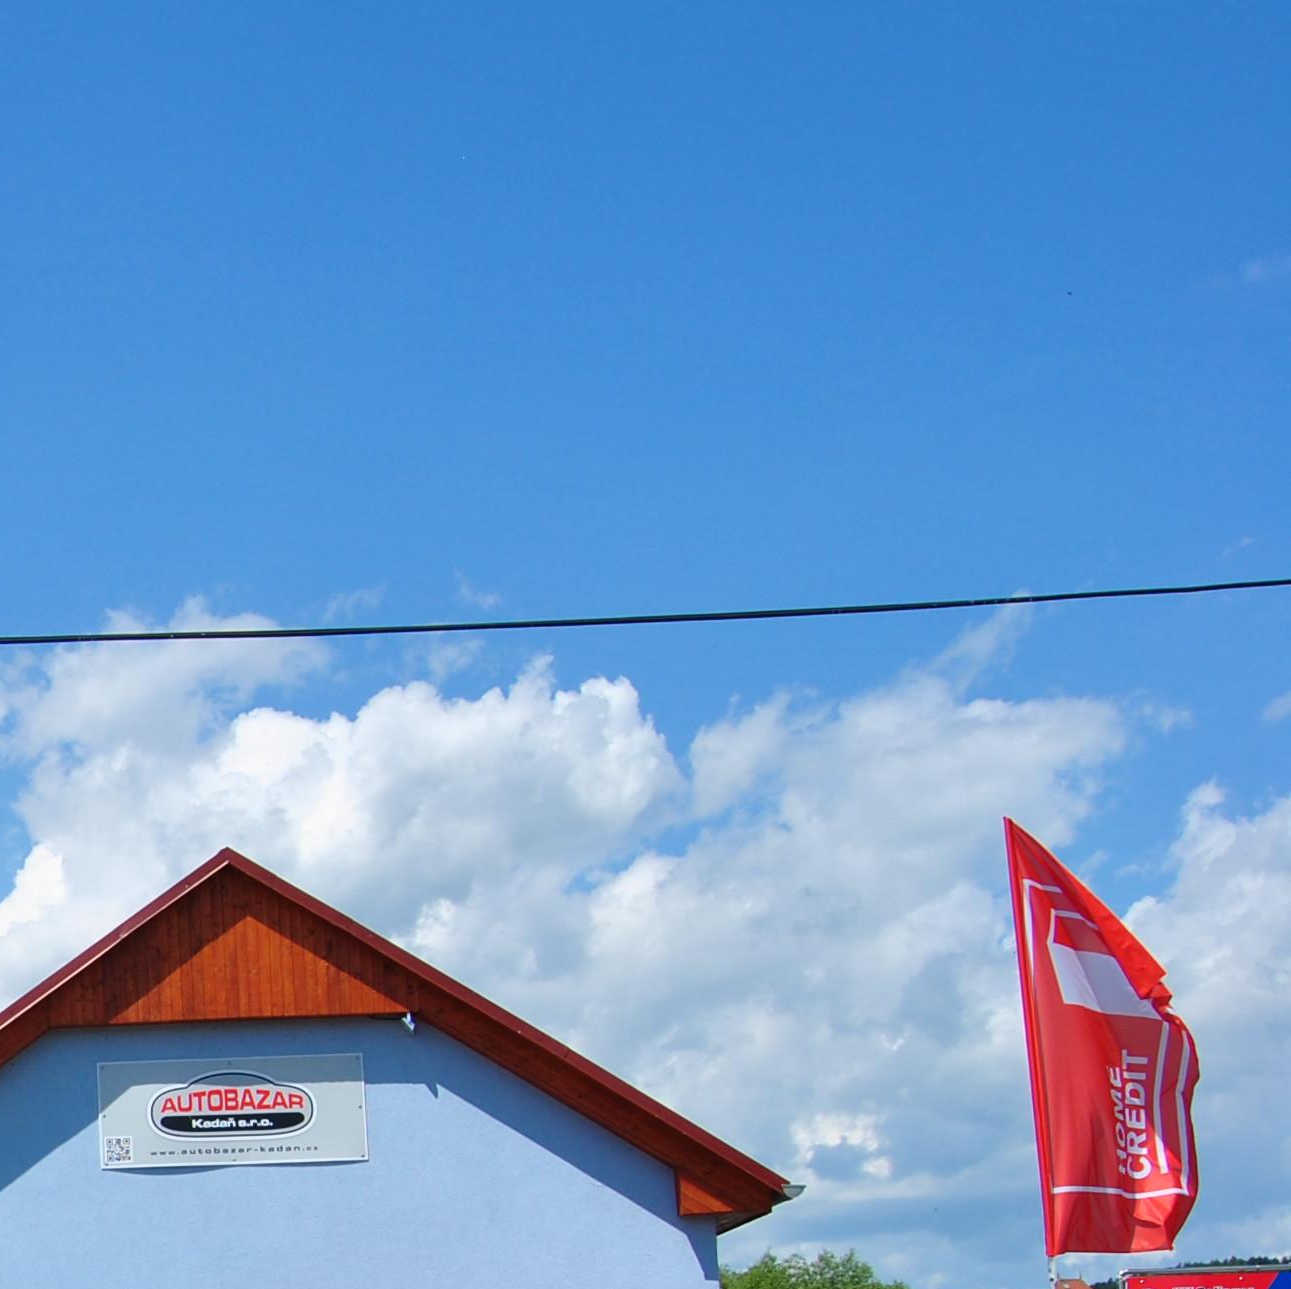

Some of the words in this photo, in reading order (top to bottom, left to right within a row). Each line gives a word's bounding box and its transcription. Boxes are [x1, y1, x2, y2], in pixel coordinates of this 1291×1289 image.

[161, 1088, 304, 1113] AUTOBAZAR
[192, 1117, 236, 1129] Kadaň
[238, 1118, 273, 1128] s.r.o.
[1107, 1066, 1127, 1174] HOME
[1122, 1049, 1152, 1180] CREDIT
[150, 1145, 319, 1156] www.autobazar-kadan.cz
